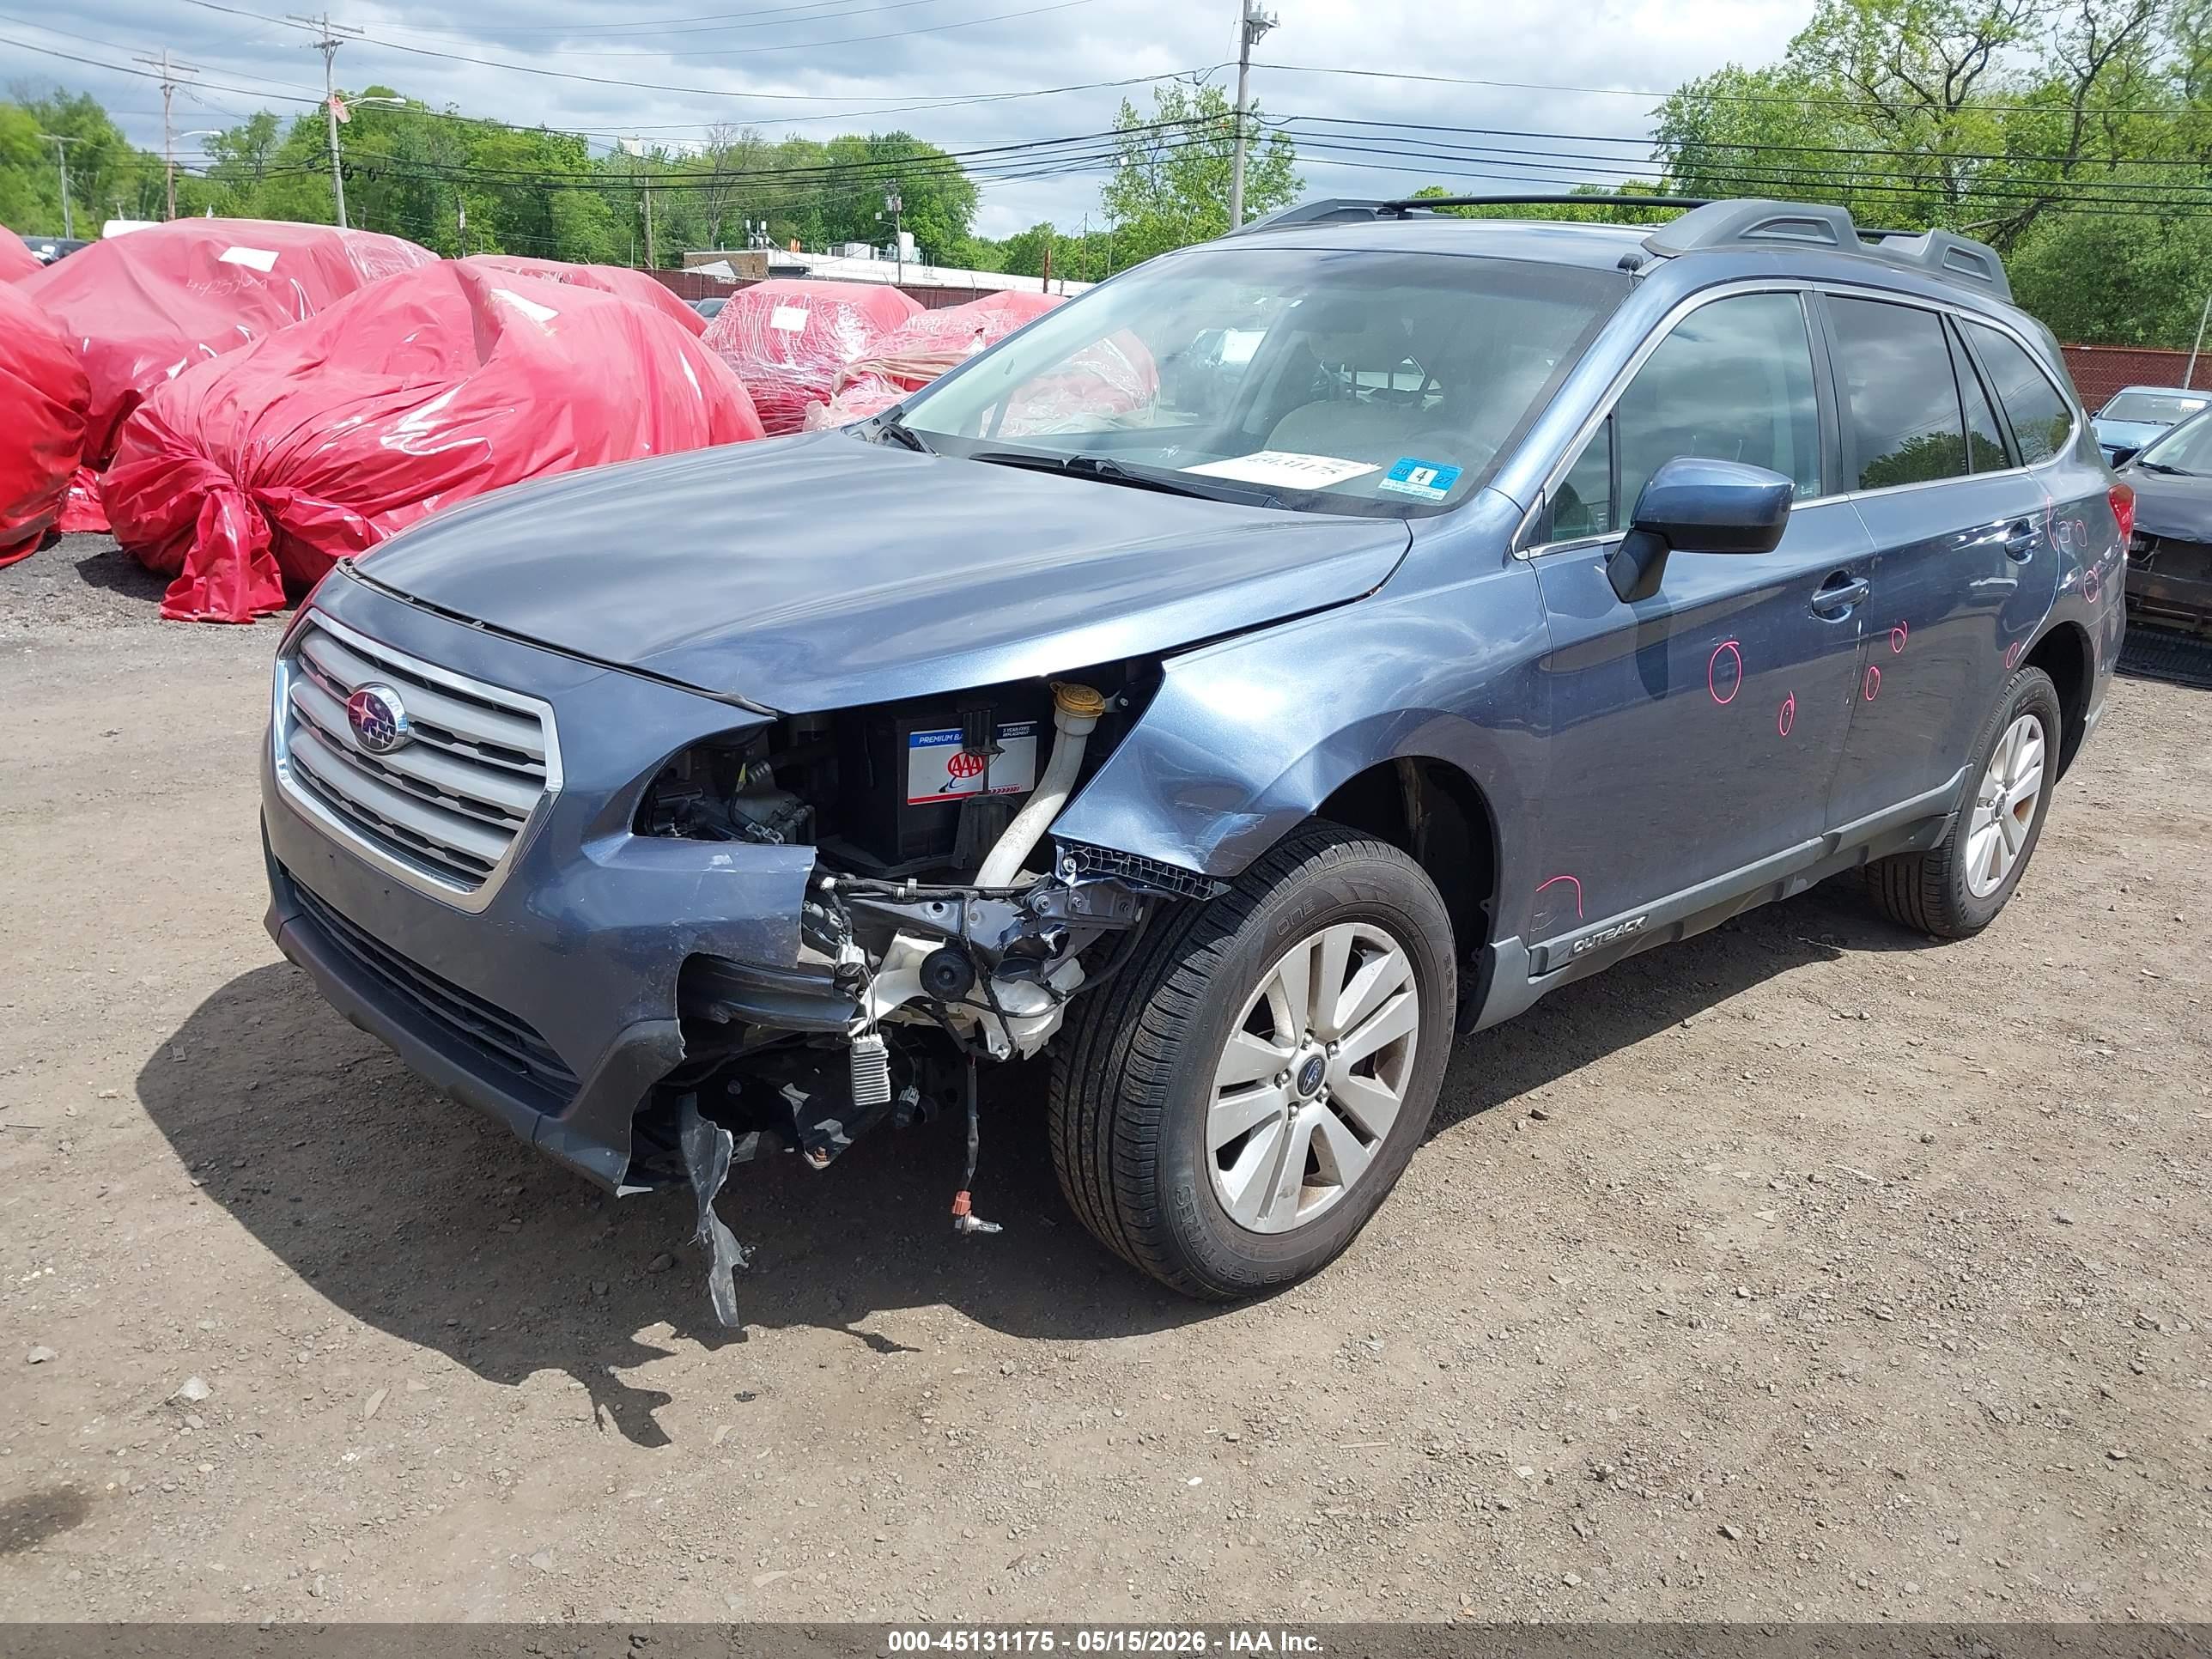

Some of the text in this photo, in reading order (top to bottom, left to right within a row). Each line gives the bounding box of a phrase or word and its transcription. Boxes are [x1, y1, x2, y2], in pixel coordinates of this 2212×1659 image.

[1393, 467, 1453, 485] 20 4 27
[919, 734, 953, 744] PREMIUM
[948, 752, 984, 778] AAA
[1573, 915, 1646, 953] OUTBACK
